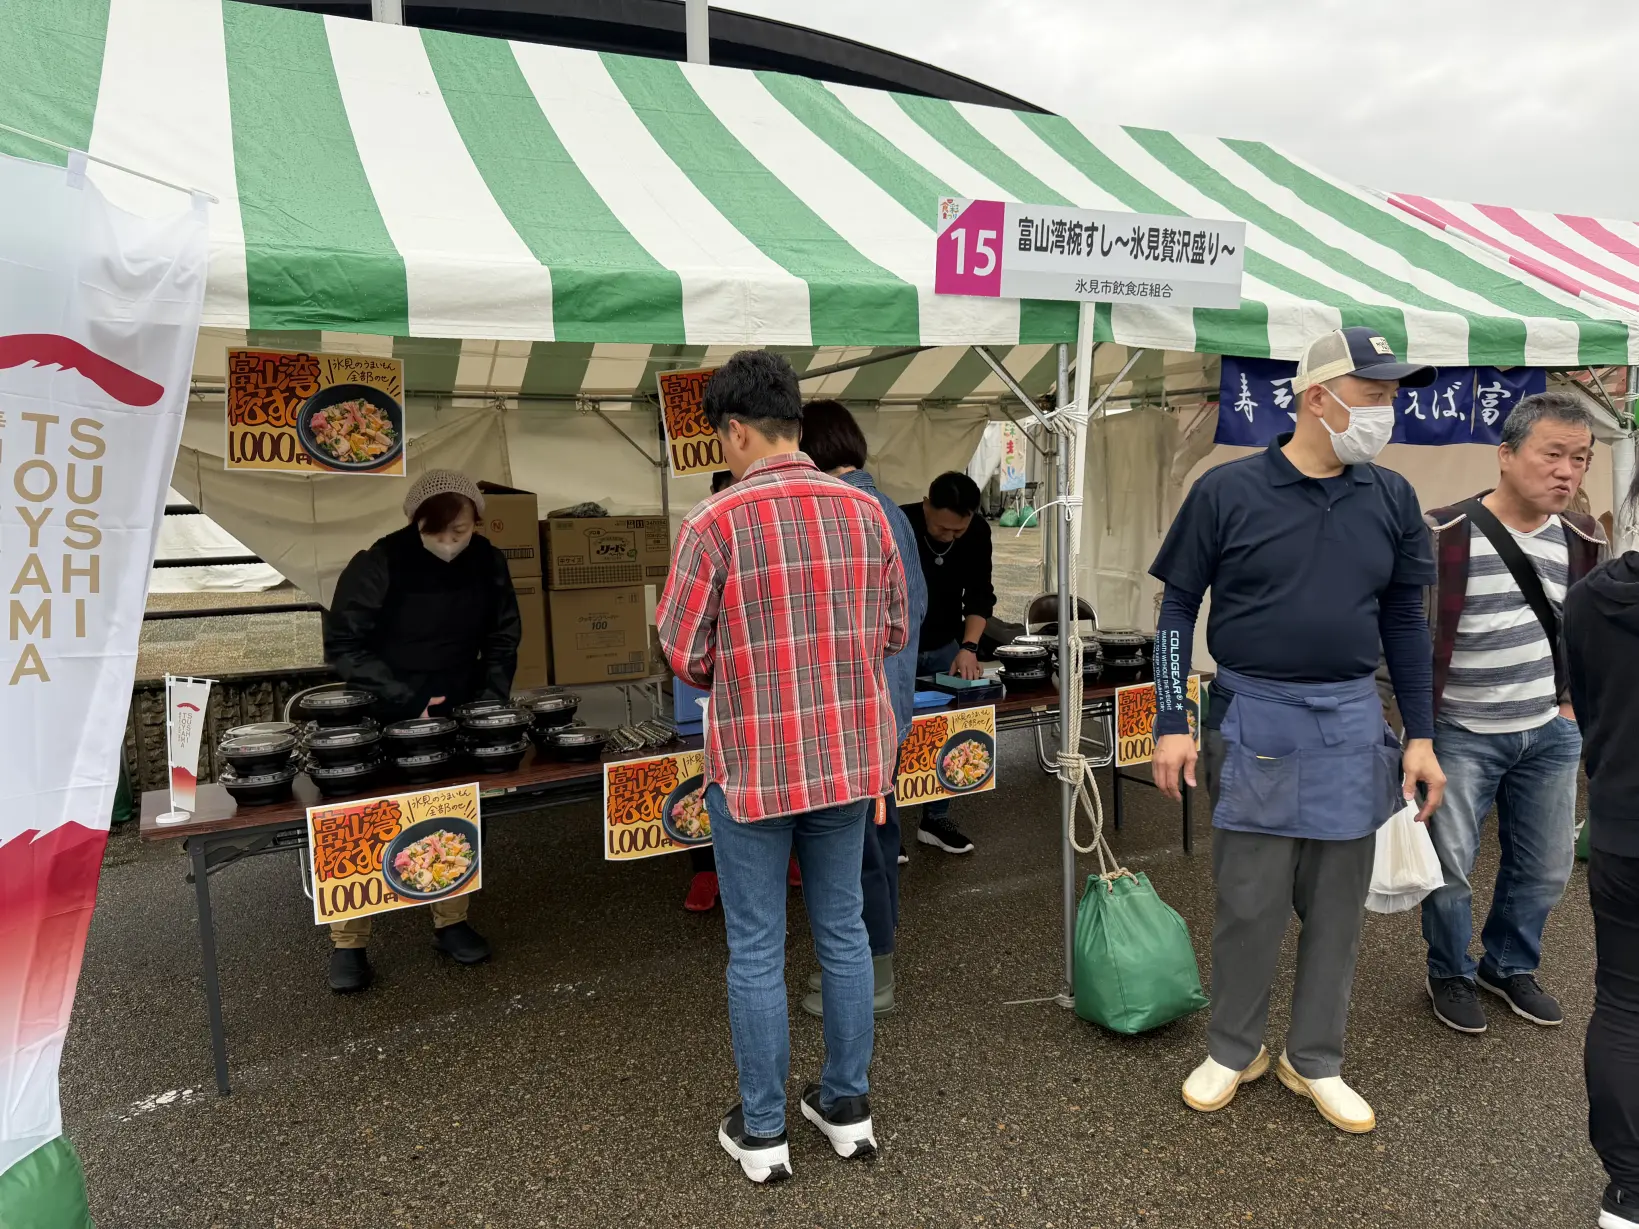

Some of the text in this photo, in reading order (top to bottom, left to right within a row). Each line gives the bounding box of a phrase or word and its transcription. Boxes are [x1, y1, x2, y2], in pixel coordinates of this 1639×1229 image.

[950, 228, 997, 276] 15
[1074, 278, 1174, 298] 氷見市飲食店組合
[228, 352, 321, 398] 富山湾
[332, 357, 396, 371] 氷見のうまいもん
[229, 431, 313, 466] 1,000円
[62, 417, 107, 638] SUSHI
[8, 411, 60, 686] TOYAMA
[591, 621, 608, 631] 100
[608, 757, 680, 796] 富山湾
[411, 788, 471, 809] 氷見のうまいもん
[312, 800, 403, 847] 富山湾
[608, 825, 673, 855] 1,000円
[318, 877, 399, 917] 1,000円
